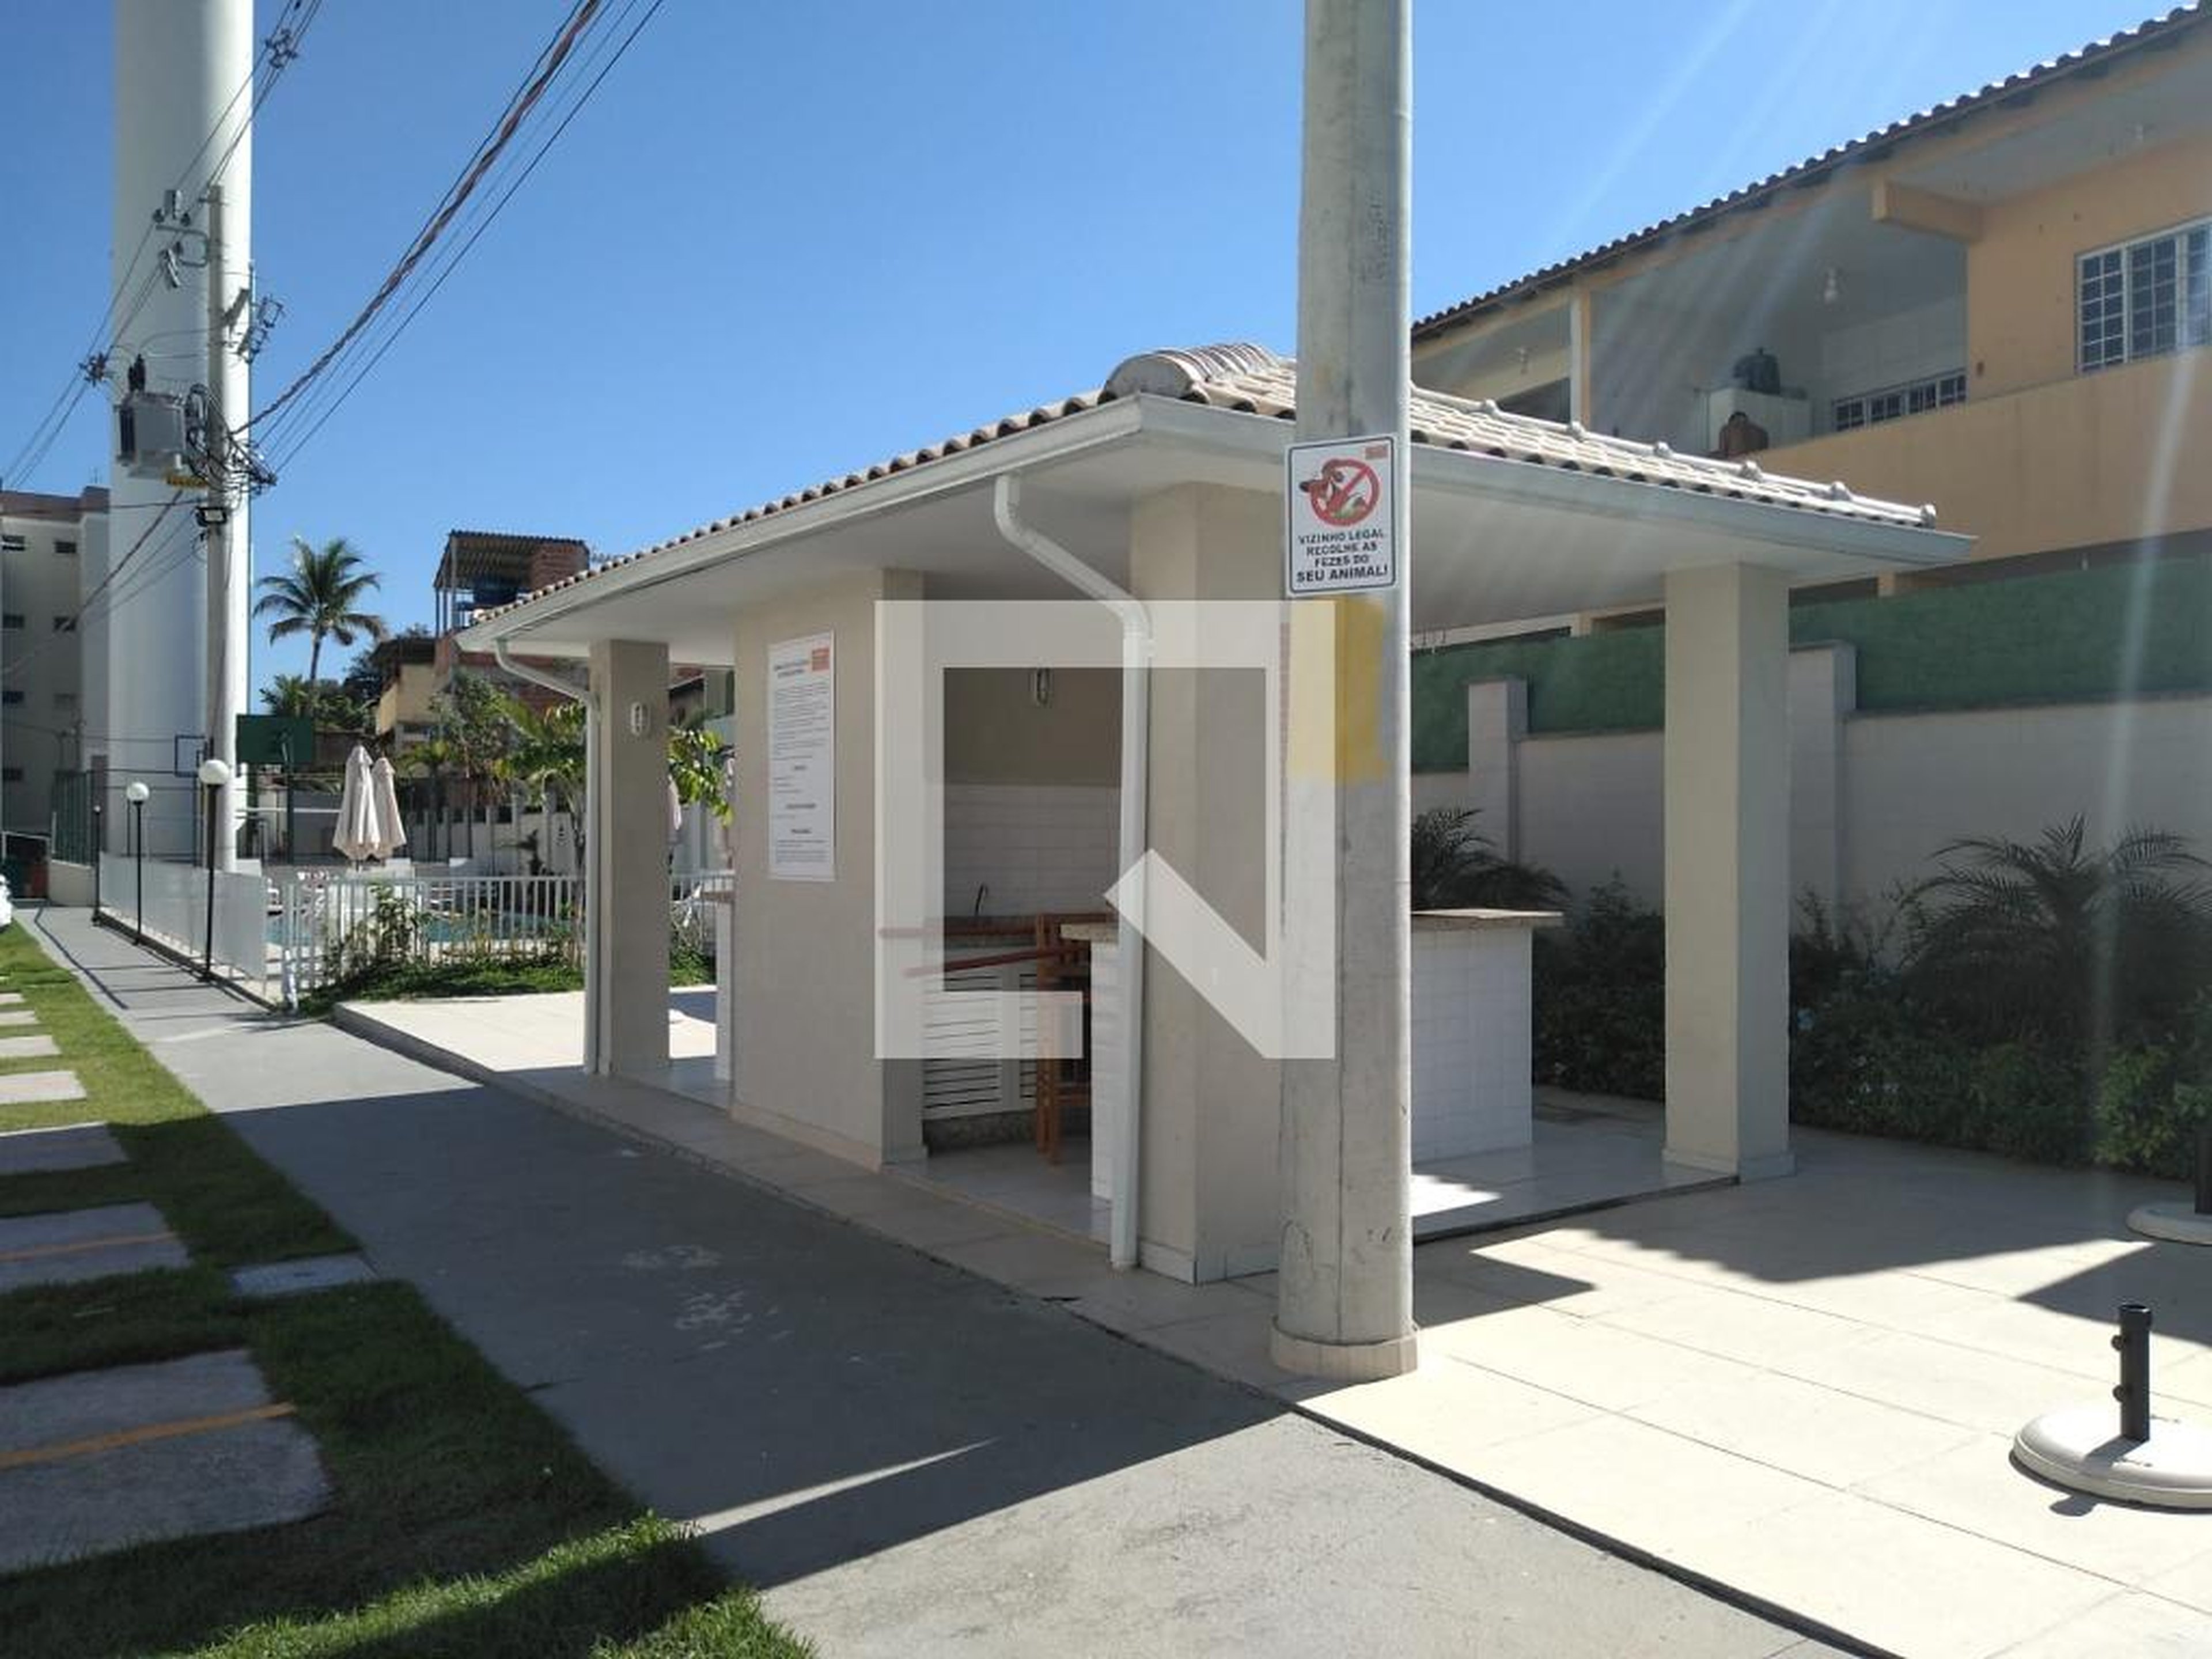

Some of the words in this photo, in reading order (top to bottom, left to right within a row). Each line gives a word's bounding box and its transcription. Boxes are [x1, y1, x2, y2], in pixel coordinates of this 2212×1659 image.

[1298, 532, 1345, 544] VIZINHO
[1349, 529, 1384, 540] LEGAL
[1306, 544, 1358, 556] RECOLHE
[1362, 541, 1377, 551] AS
[1315, 555, 1350, 567] FEZES
[1354, 554, 1369, 564] DO
[1297, 570, 1324, 582] SEU
[1330, 565, 1388, 579] ANIMAL!
